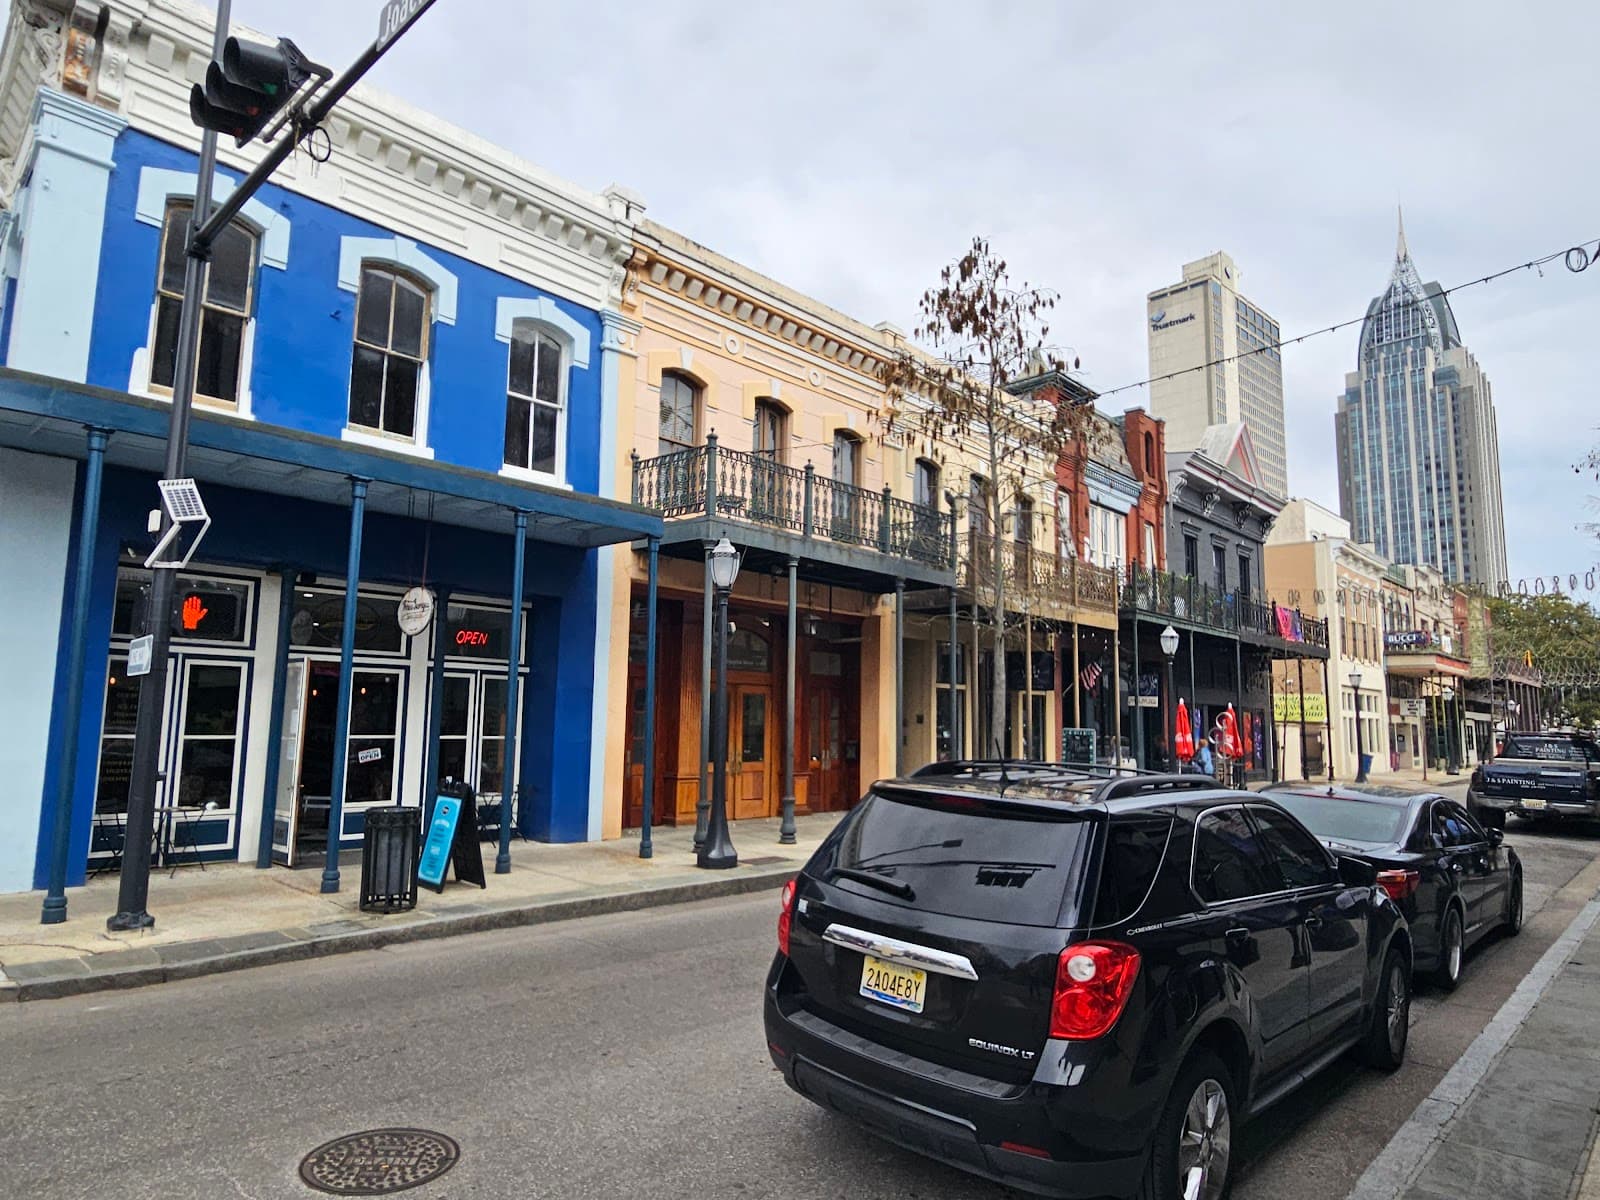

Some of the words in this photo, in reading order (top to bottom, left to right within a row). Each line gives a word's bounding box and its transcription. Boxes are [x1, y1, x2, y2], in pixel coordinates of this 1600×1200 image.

[380, 0, 422, 42] Joac
[1151, 313, 1196, 331] Trustmark
[455, 630, 489, 645] OPEN
[1502, 778, 1536, 787] PAINTING
[866, 967, 921, 1001] 2A04E8Y
[968, 1038, 1019, 1057] EQUINOX
[1021, 1050, 1035, 1059] LT
